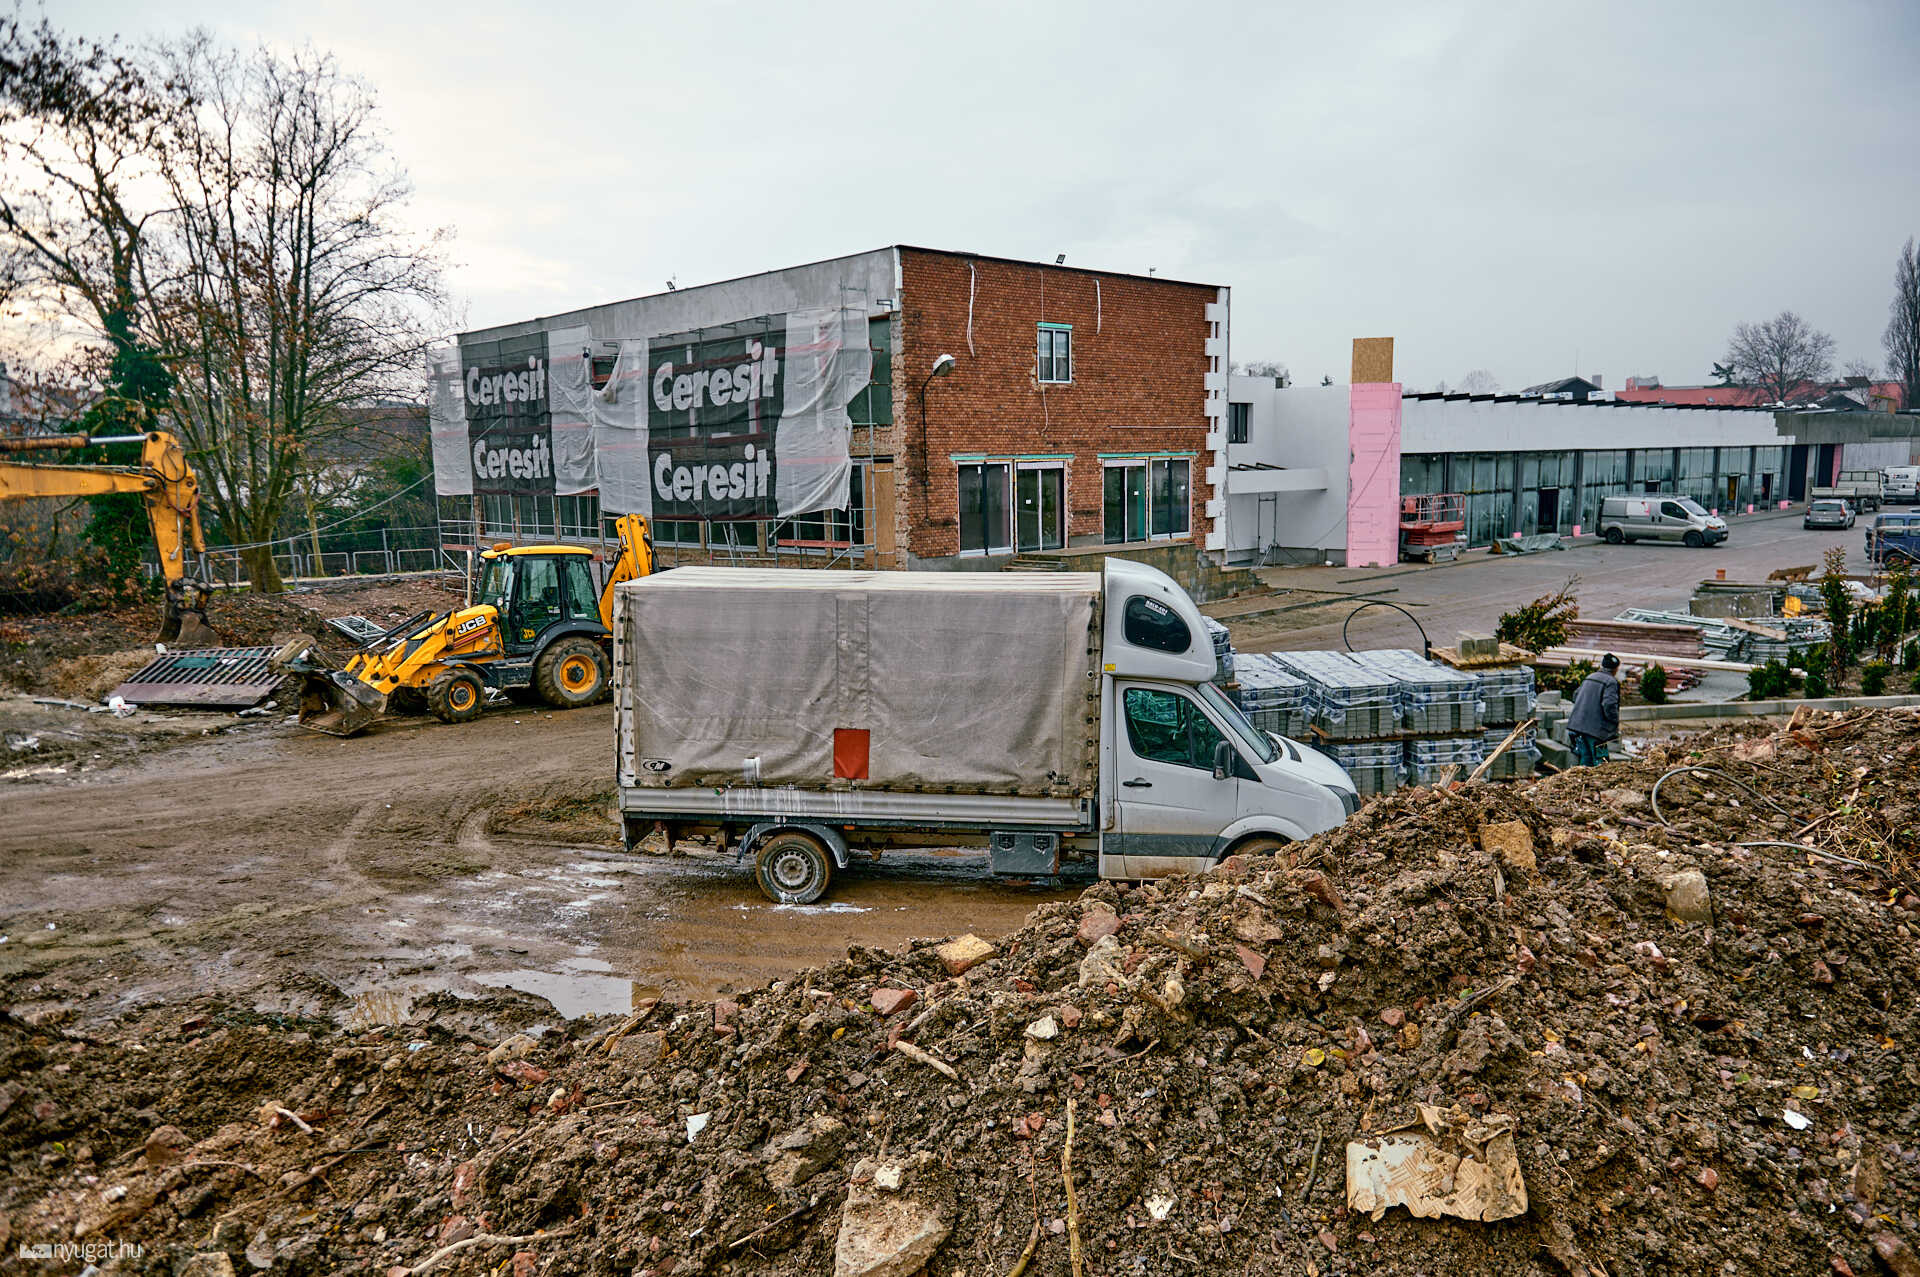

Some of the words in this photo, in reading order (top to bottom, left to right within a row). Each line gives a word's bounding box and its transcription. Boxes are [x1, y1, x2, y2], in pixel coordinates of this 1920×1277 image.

[467, 356, 545, 405] Ceresit
[653, 341, 778, 411] Ceresit
[473, 434, 550, 479] Ceresit
[655, 444, 770, 500] Ceresit
[458, 615, 487, 634] JCB
